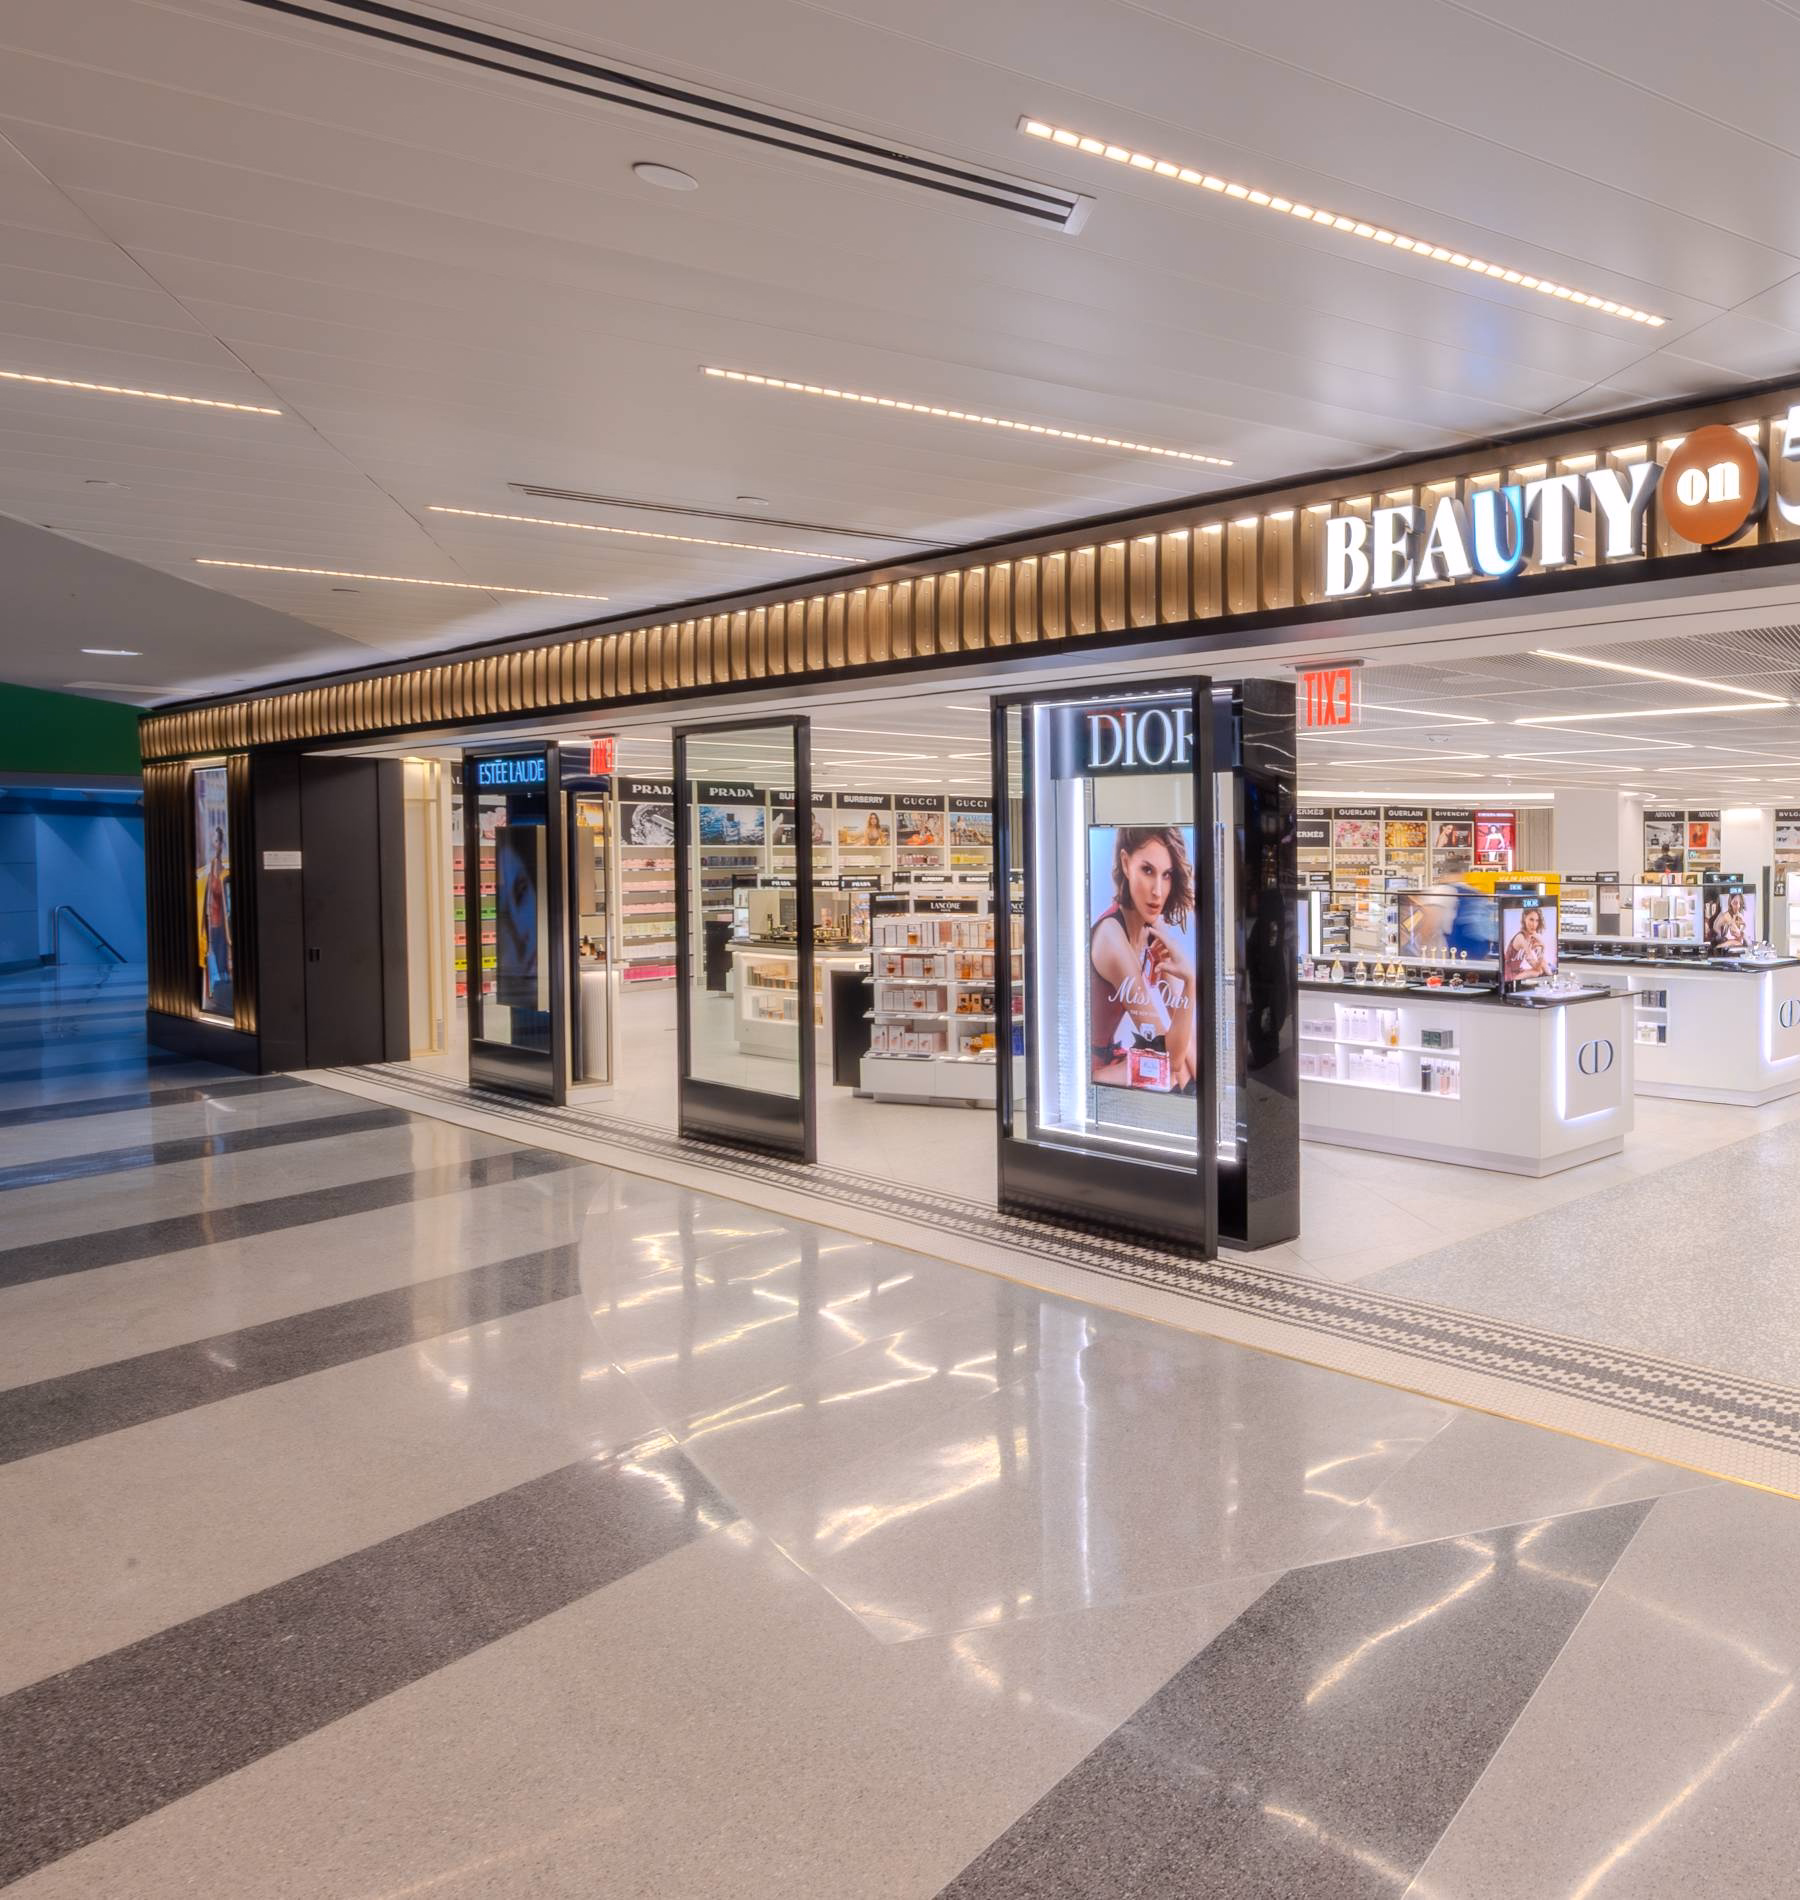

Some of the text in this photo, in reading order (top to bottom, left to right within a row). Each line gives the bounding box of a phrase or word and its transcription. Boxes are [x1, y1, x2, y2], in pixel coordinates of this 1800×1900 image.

[1325, 462, 1661, 597] BEAUTY
[1676, 460, 1742, 507] on
[510, 759, 545, 783] LAUDE
[632, 784, 674, 795] PRAD
[709, 787, 754, 798] PRADA
[843, 795, 884, 804] BURBERRY
[903, 797, 937, 806] GUCCI
[956, 799, 988, 808] GUCCI
[1339, 808, 1377, 816] GUERLAIN
[1388, 809, 1424, 817] GUERLAIN
[1108, 975, 1151, 1006] Miss
